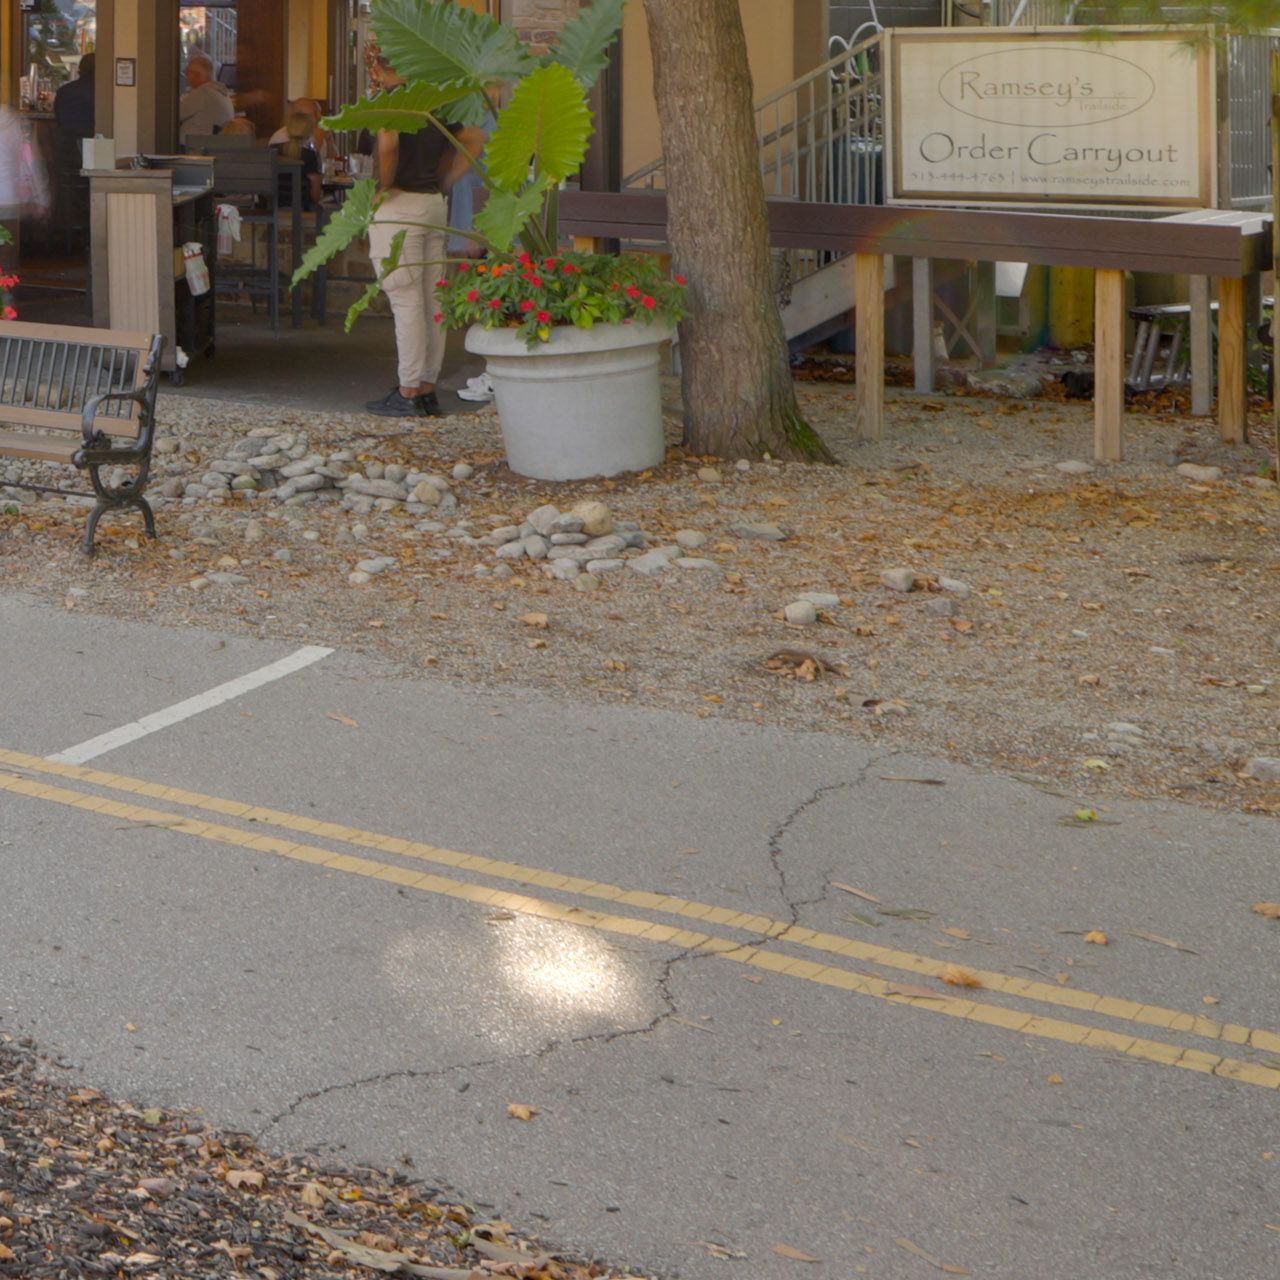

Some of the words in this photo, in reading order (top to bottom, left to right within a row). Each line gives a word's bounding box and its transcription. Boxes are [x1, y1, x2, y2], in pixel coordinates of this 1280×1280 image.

[959, 71, 1095, 107] Ramsey's
[919, 131, 1019, 163] Order
[1027, 133, 1178, 172] Carryout
